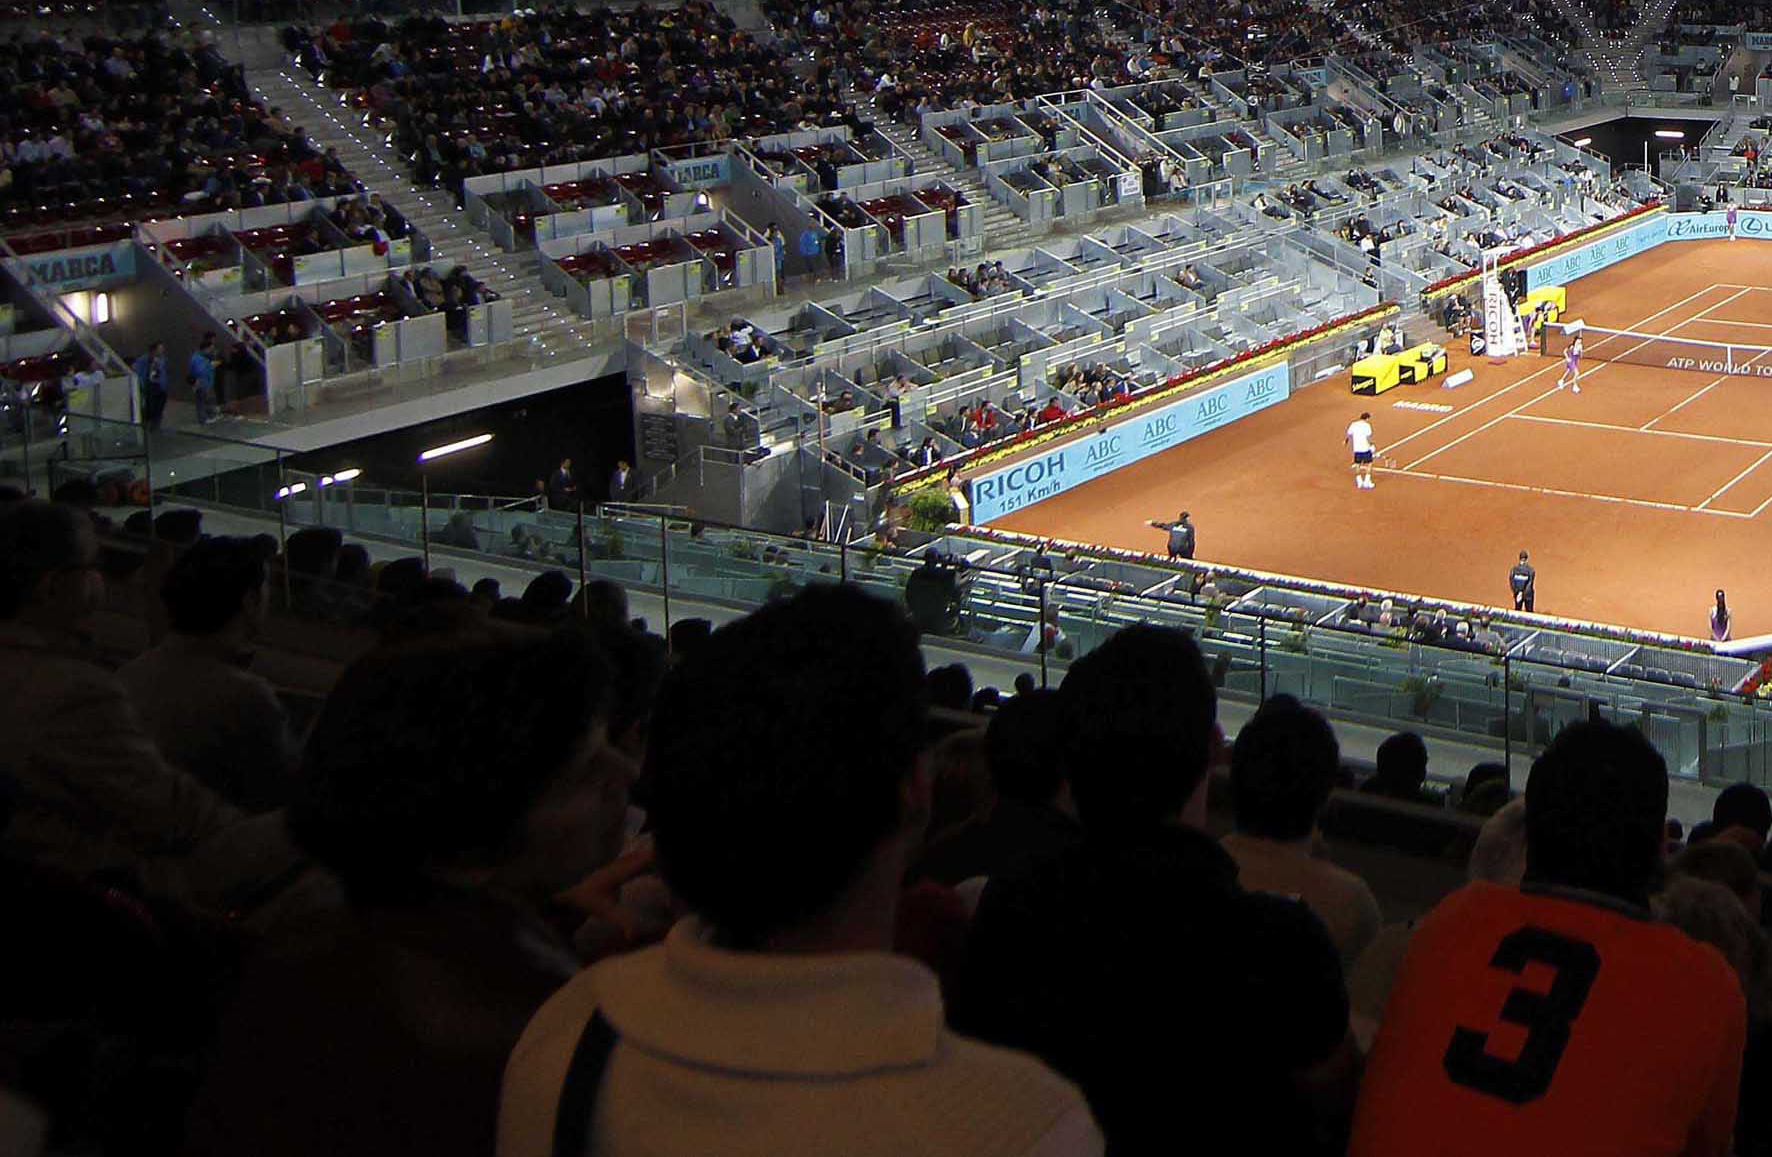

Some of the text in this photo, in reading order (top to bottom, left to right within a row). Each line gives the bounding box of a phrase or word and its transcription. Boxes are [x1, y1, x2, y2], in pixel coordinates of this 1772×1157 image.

[1690, 224, 1729, 234] AirEurop
[1488, 293, 1498, 345] RICOH
[1666, 357, 1695, 369] ATP
[1245, 375, 1275, 400] ABC
[1197, 394, 1229, 420] ABC
[1143, 413, 1177, 441] ABC
[1085, 436, 1121, 464] ABC
[975, 452, 1065, 505] RICOH
[1000, 480, 1061, 513] 151 Km/h
[1443, 925, 1602, 1106] 3
